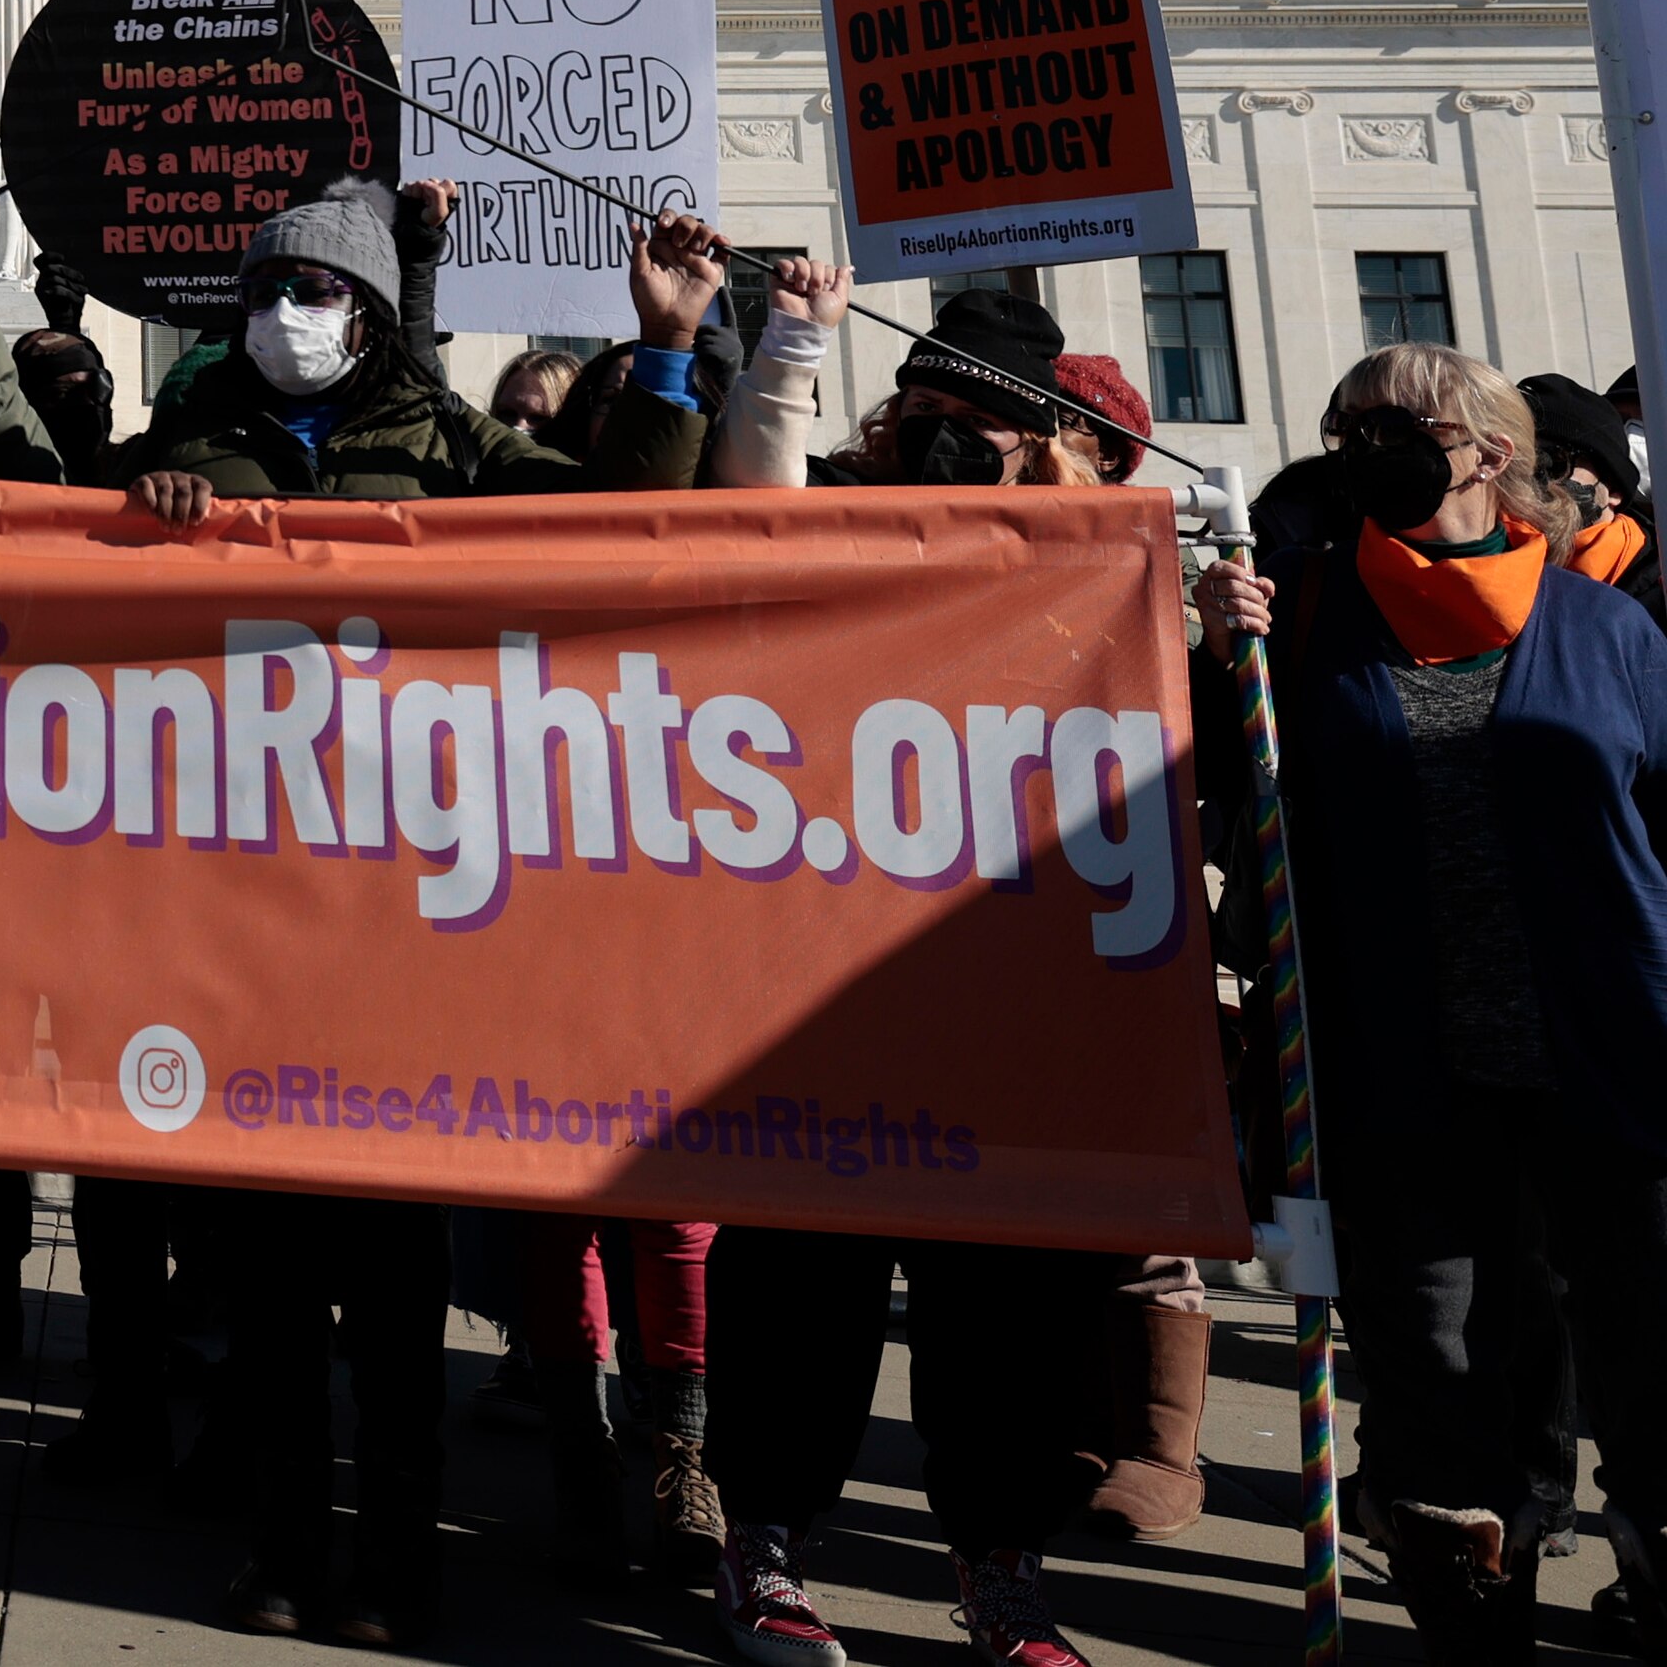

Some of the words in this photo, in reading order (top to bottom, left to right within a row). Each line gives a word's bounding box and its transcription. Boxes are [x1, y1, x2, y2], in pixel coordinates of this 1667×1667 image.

[114, 19, 165, 42] the
[174, 15, 278, 39] Chains
[848, 5, 910, 64] ON
[102, 59, 236, 90] Unleash
[247, 57, 304, 84] the
[858, 82, 895, 131] &
[901, 41, 1137, 123] WITHOUT
[78, 99, 151, 131] Fury
[161, 96, 197, 124] of
[207, 94, 332, 122] Women
[412, 50, 691, 156] FORCED
[103, 149, 146, 176] As
[158, 154, 178, 174] a
[190, 144, 309, 177] Mighty
[896, 113, 1114, 193] APOLOGY
[127, 187, 221, 214] Force
[234, 184, 289, 212] For
[102, 223, 264, 253] REVOLUT
[436, 175, 703, 270] IRTHIN
[900, 215, 1134, 257] RiseUp4AbortionRights.org
[222, 1064, 981, 1179] @Rise4AbortionRights
